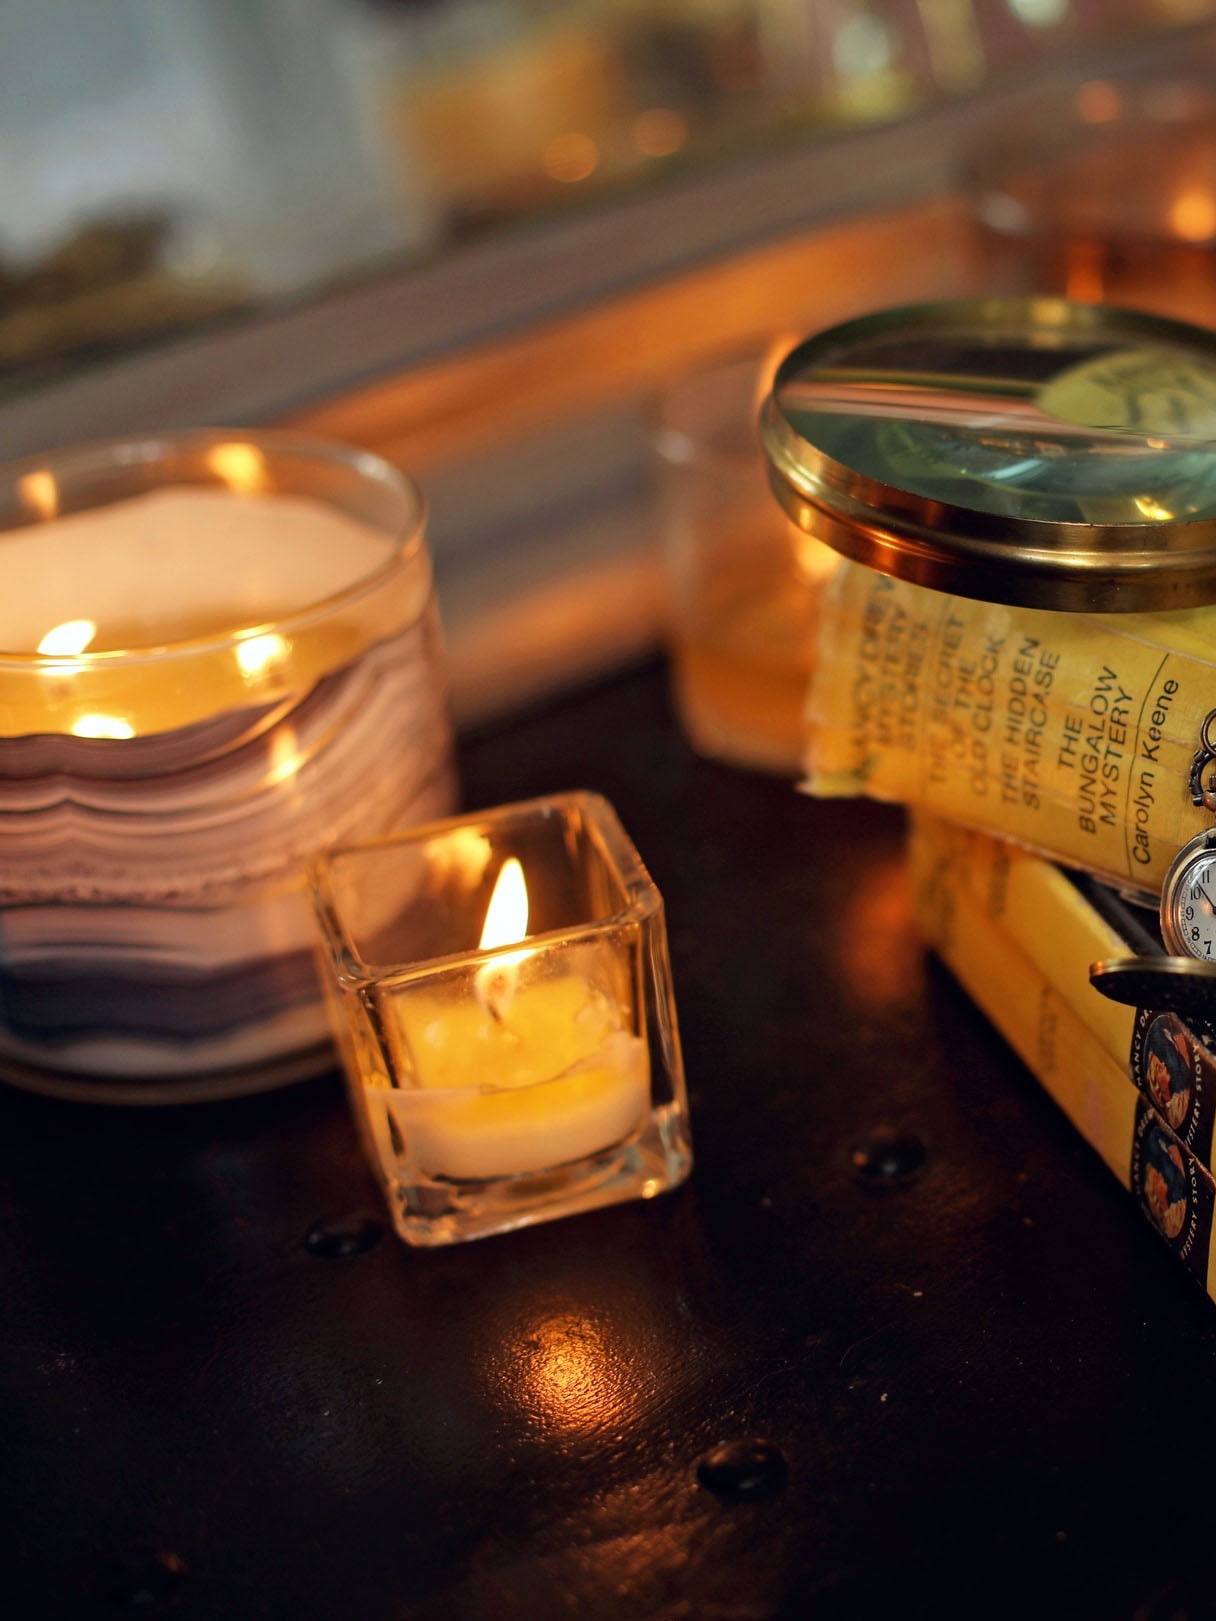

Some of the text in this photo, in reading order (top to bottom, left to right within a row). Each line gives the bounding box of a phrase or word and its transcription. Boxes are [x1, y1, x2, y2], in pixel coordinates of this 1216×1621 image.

[900, 622, 928, 749] STORIES
[935, 613, 964, 722] SECRET
[952, 660, 976, 711] THE
[970, 634, 1006, 796] OLD CLOCK
[1002, 636, 1040, 806] THE HIDDEN
[1023, 652, 1060, 810] STAIRCASE
[1058, 714, 1083, 770] THE
[1079, 665, 1120, 835] BUNGALOW
[1101, 686, 1133, 826] MYSTERY
[1132, 678, 1180, 865] Carolyn Keene
[1186, 906, 1194, 920] 9
[1191, 887, 1201, 900] 10
[1202, 870, 1210, 883] 11
[1191, 927, 1200, 941] 8
[1204, 941, 1212, 954] 7
[1185, 1044, 1202, 1146] YSTERY STORY
[1188, 1157, 1198, 1204] STORY
